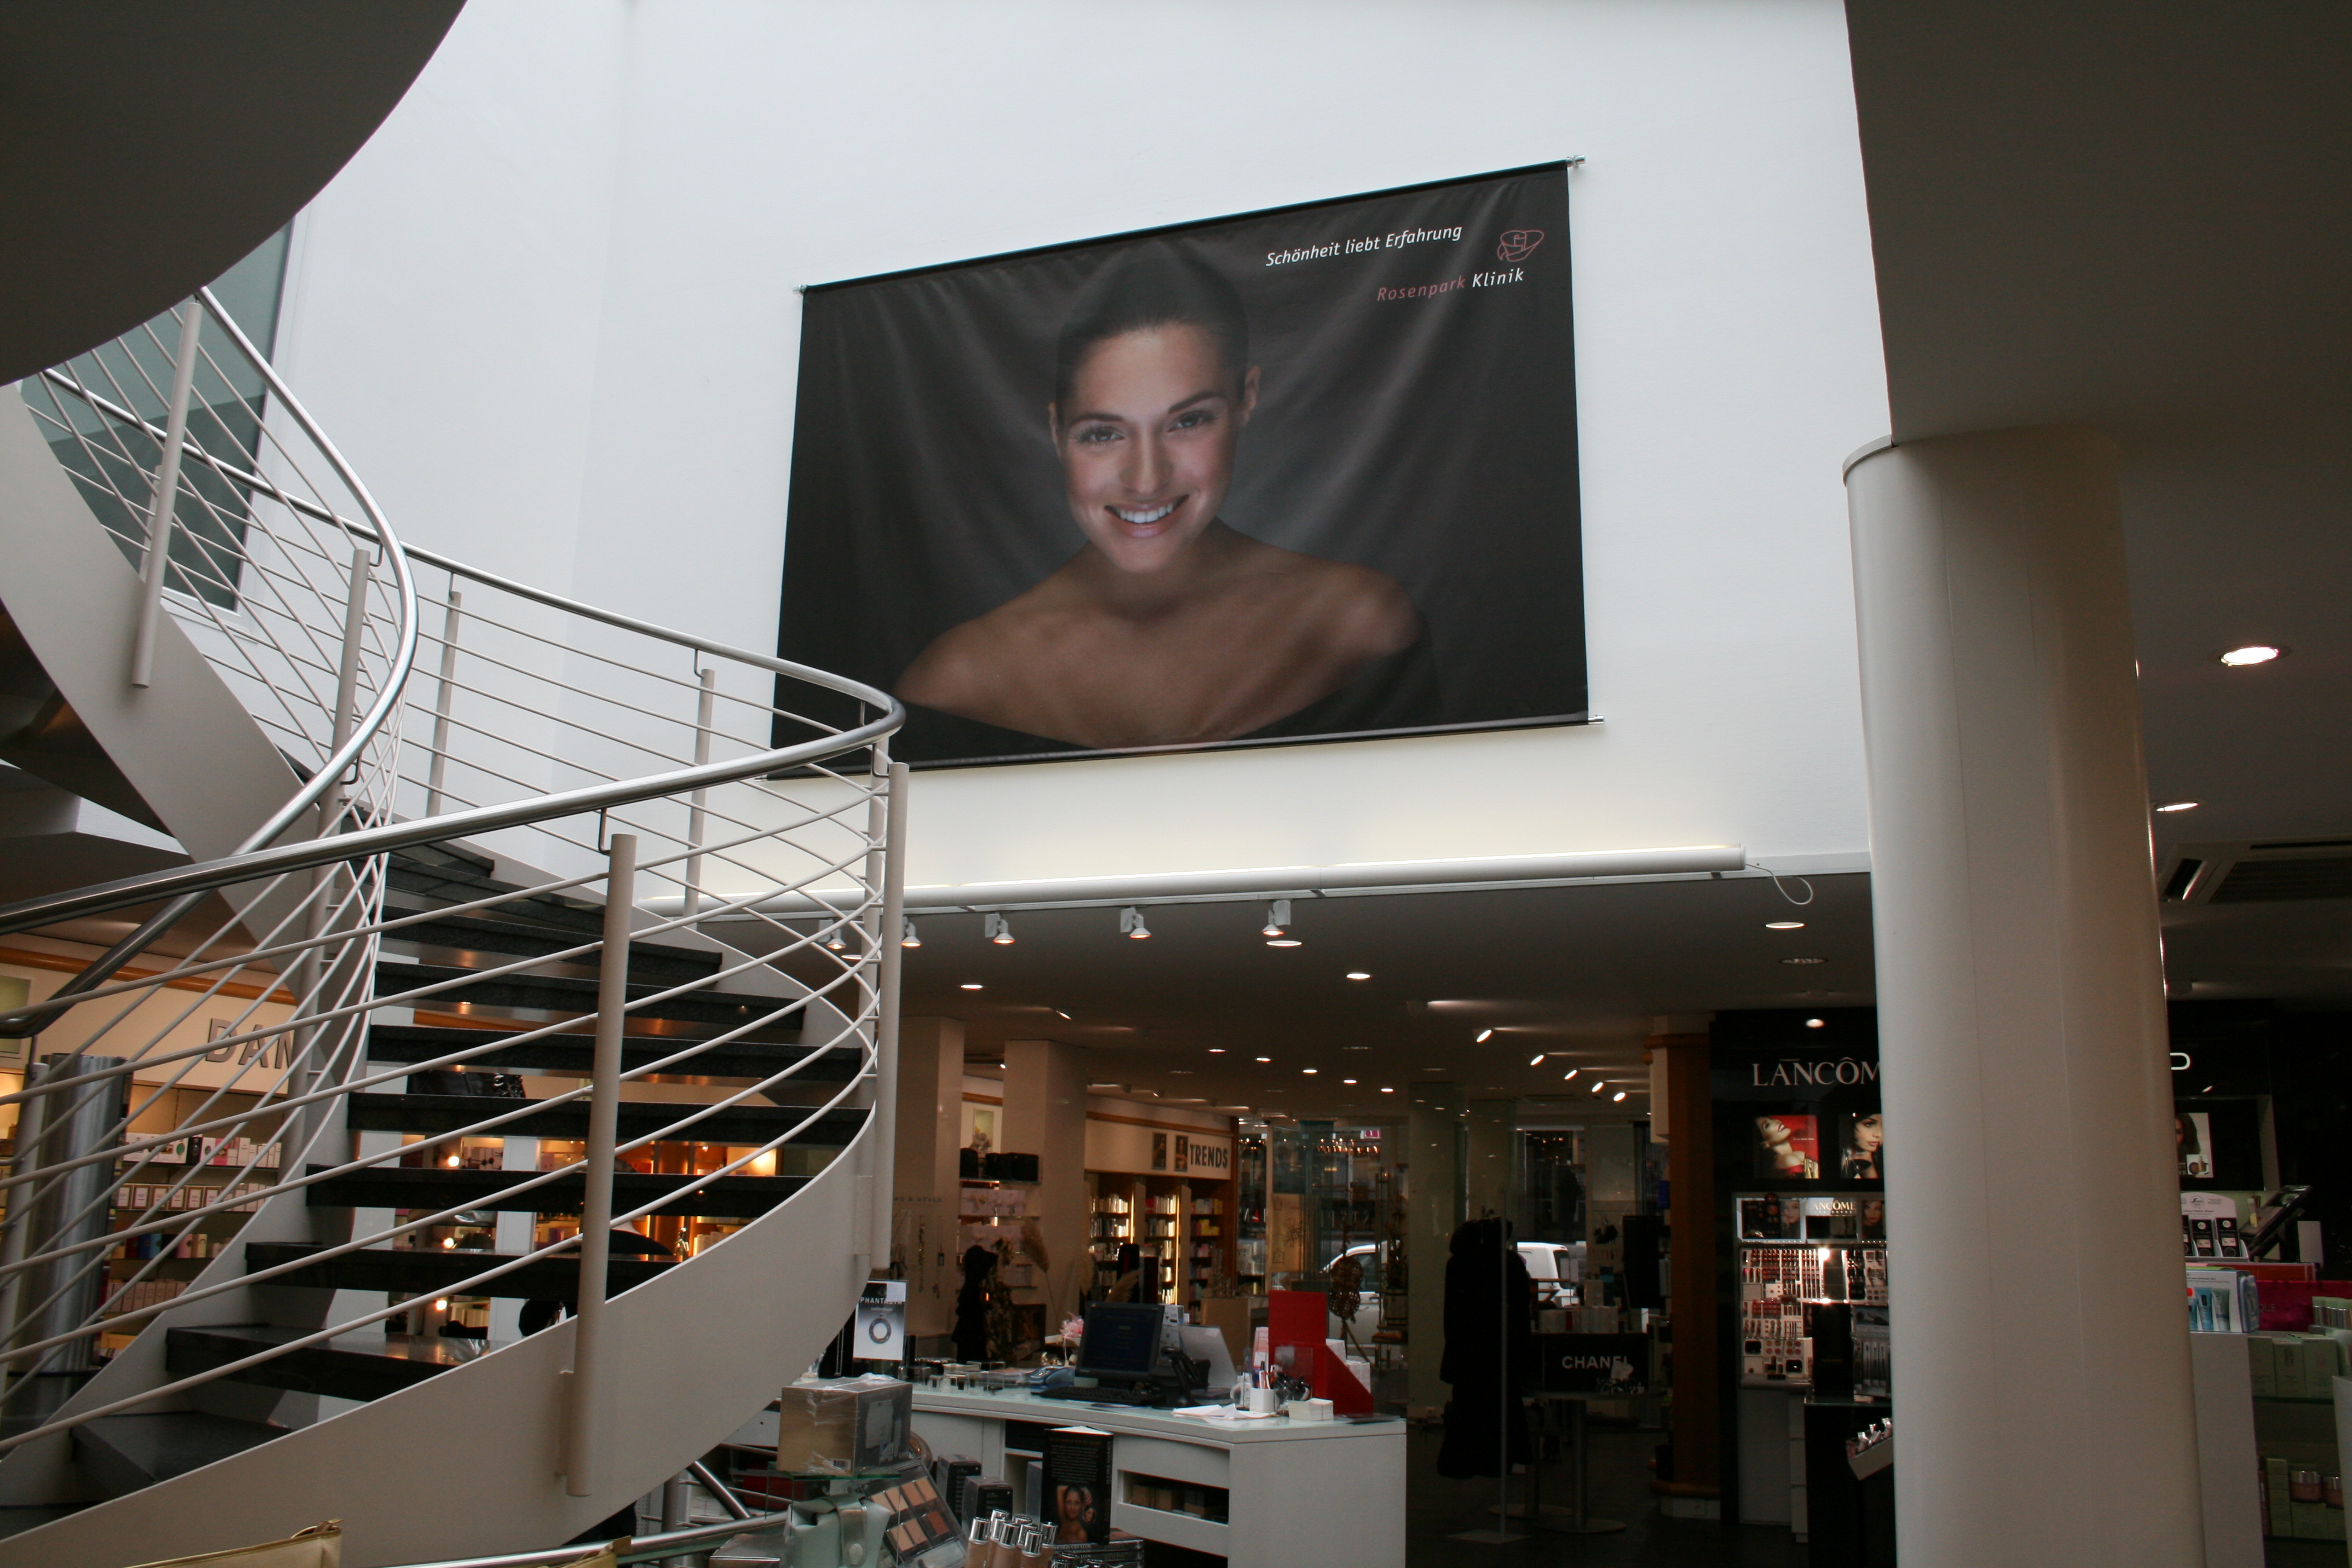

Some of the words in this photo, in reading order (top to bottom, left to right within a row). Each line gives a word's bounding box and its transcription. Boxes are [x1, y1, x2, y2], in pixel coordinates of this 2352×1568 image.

[1266, 242, 1341, 266] Schönheit
[1345, 237, 1380, 254] liebt
[1385, 226, 1462, 249] Erfahrung
[1377, 275, 1466, 301] Rosenpark
[1472, 267, 1524, 287] Klinik
[1752, 1057, 1880, 1086] LANCÔM
[1190, 1144, 1227, 1168] TRENDS
[1810, 1200, 1857, 1210] ANCÔME
